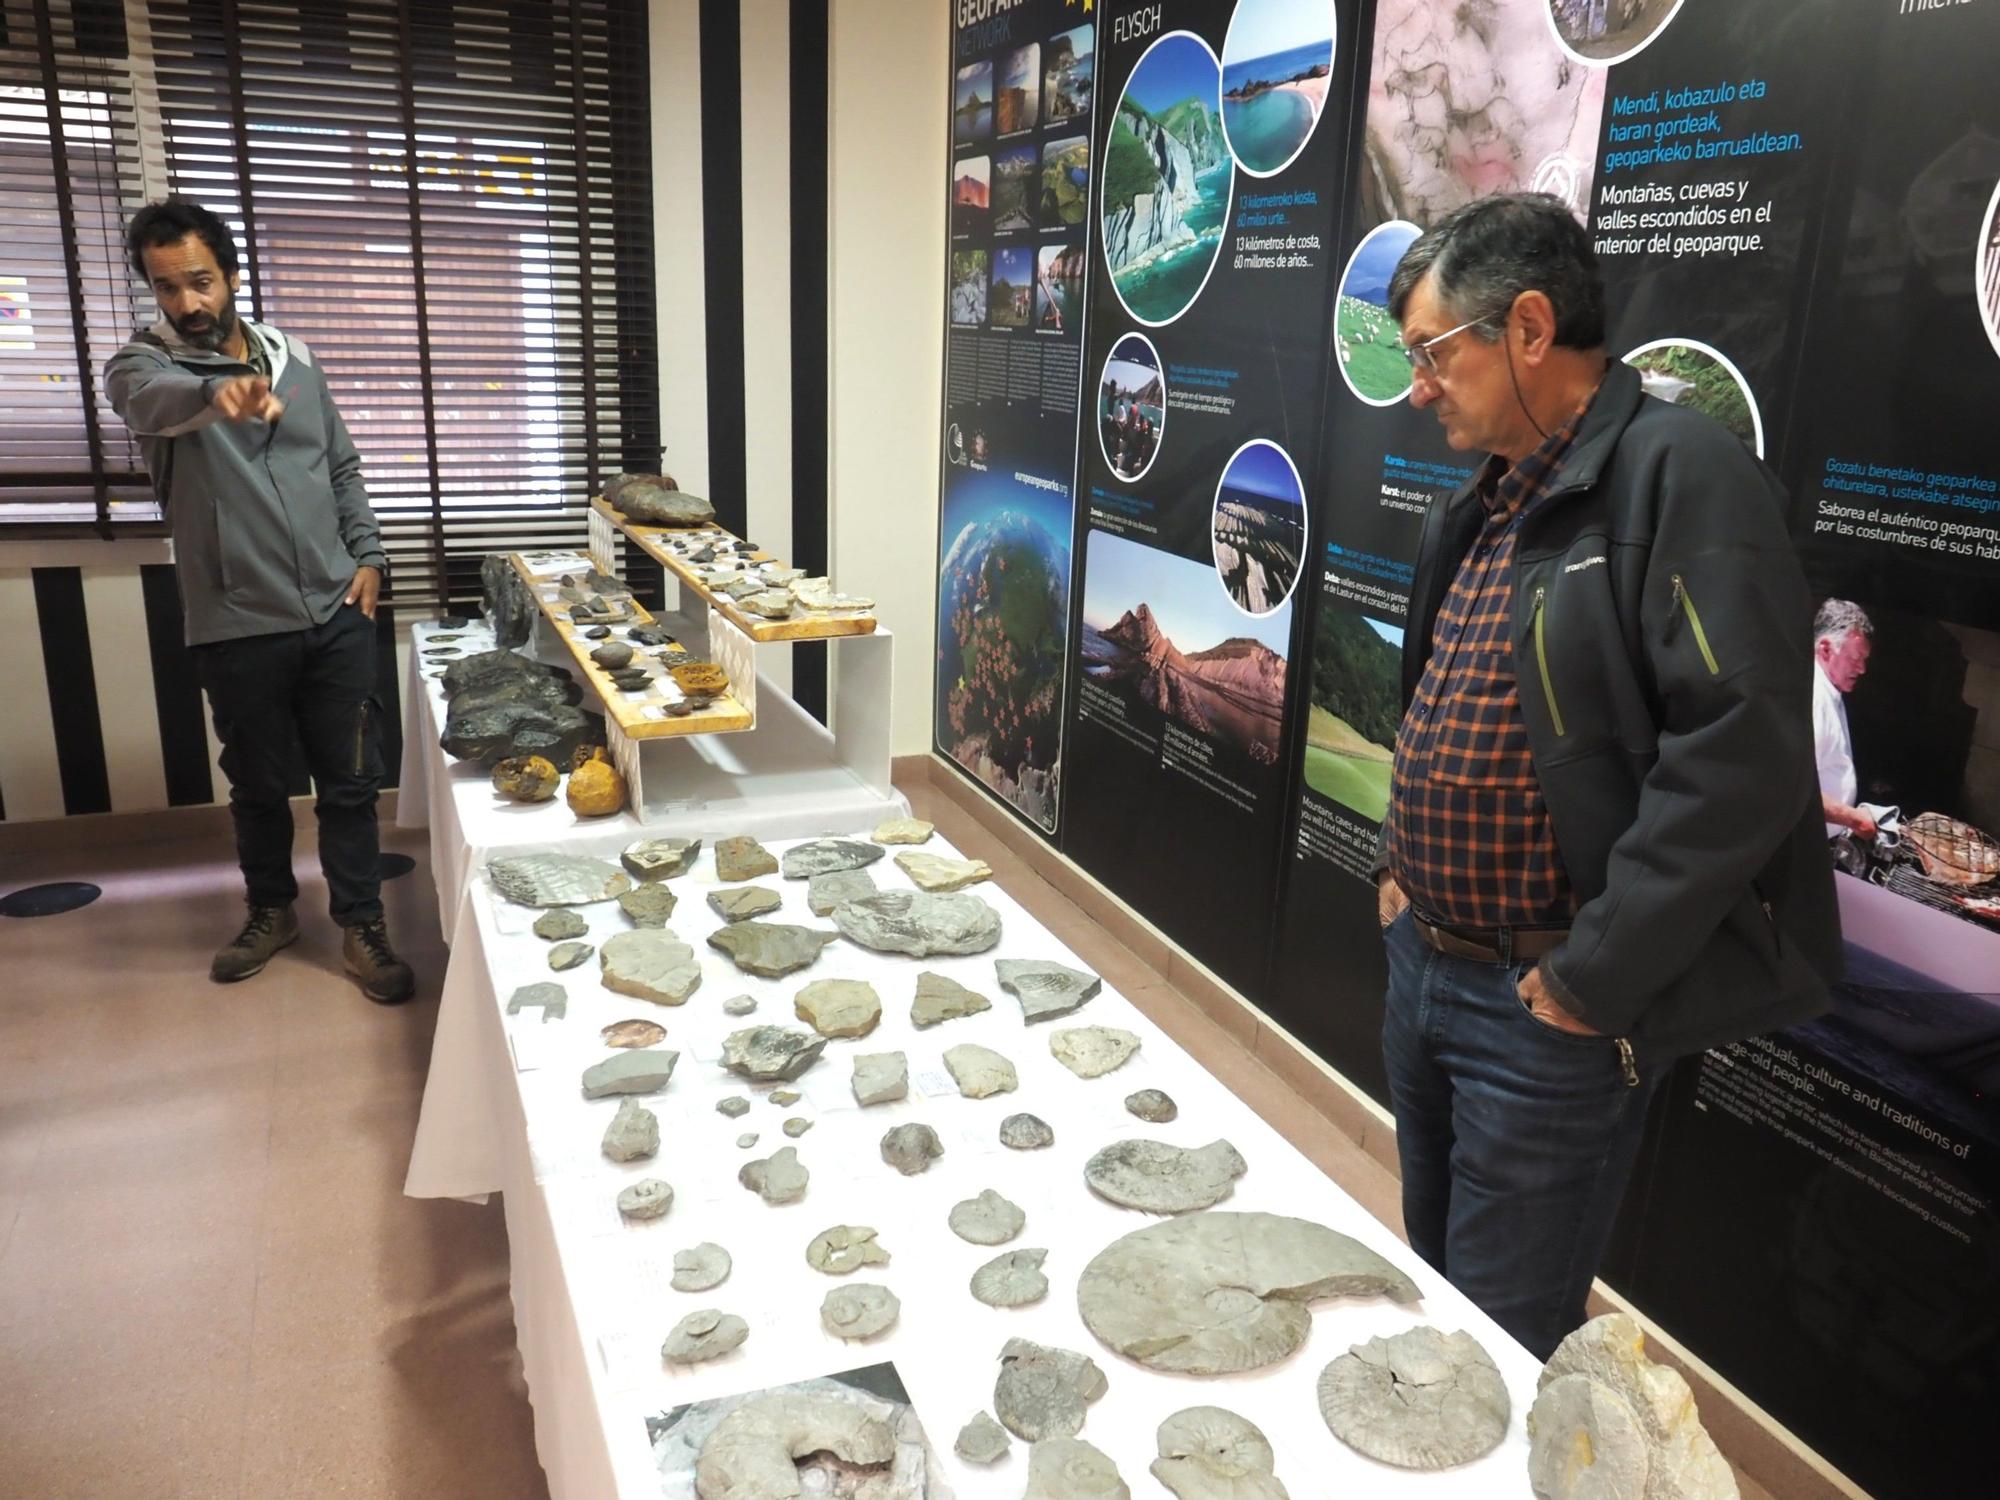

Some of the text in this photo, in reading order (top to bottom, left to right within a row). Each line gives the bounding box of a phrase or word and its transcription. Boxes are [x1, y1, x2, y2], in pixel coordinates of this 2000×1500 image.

[1113, 3, 1162, 44] FLYSCH
[1612, 79, 1766, 117] Mendi, kobazulo eta
[1608, 110, 1721, 143] haran gordeak,
[1605, 131, 1803, 173] geoparkeko barrualdean.
[1600, 180, 1749, 206] Montañas, cuevas y
[1597, 201, 1772, 230] valles escondidos en el
[1236, 234, 1321, 252] 13 kilómetros de costa,
[1593, 232, 1764, 259] interior del geoparque.
[1233, 251, 1314, 269] 60 millones de años...
[1822, 475, 1889, 498] ohituretara,
[1891, 485, 1950, 504] ustekabe
[1825, 457, 1997, 492] Gozatu benetako geoparkea
[1380, 498, 1426, 514] un universo con
[1407, 489, 1425, 502] poder
[1817, 500, 2000, 545] Saborea el auténtico geoparqu
[1815, 520, 2000, 561] por las costumbres de sus hab
[1355, 578, 1387, 598] escondidos
[1301, 809, 1312, 821] you
[1312, 813, 1323, 828] will
[1323, 819, 1335, 834] find
[1336, 827, 1352, 843] them
[1335, 815, 1353, 831] caves
[1353, 824, 1366, 838] and
[1772, 1064, 1825, 1102] people...
[1803, 1062, 1852, 1095] culture
[1852, 1090, 1881, 1112] and
[1882, 1103, 1952, 1151] traditions
[1953, 1143, 1971, 1160] of
